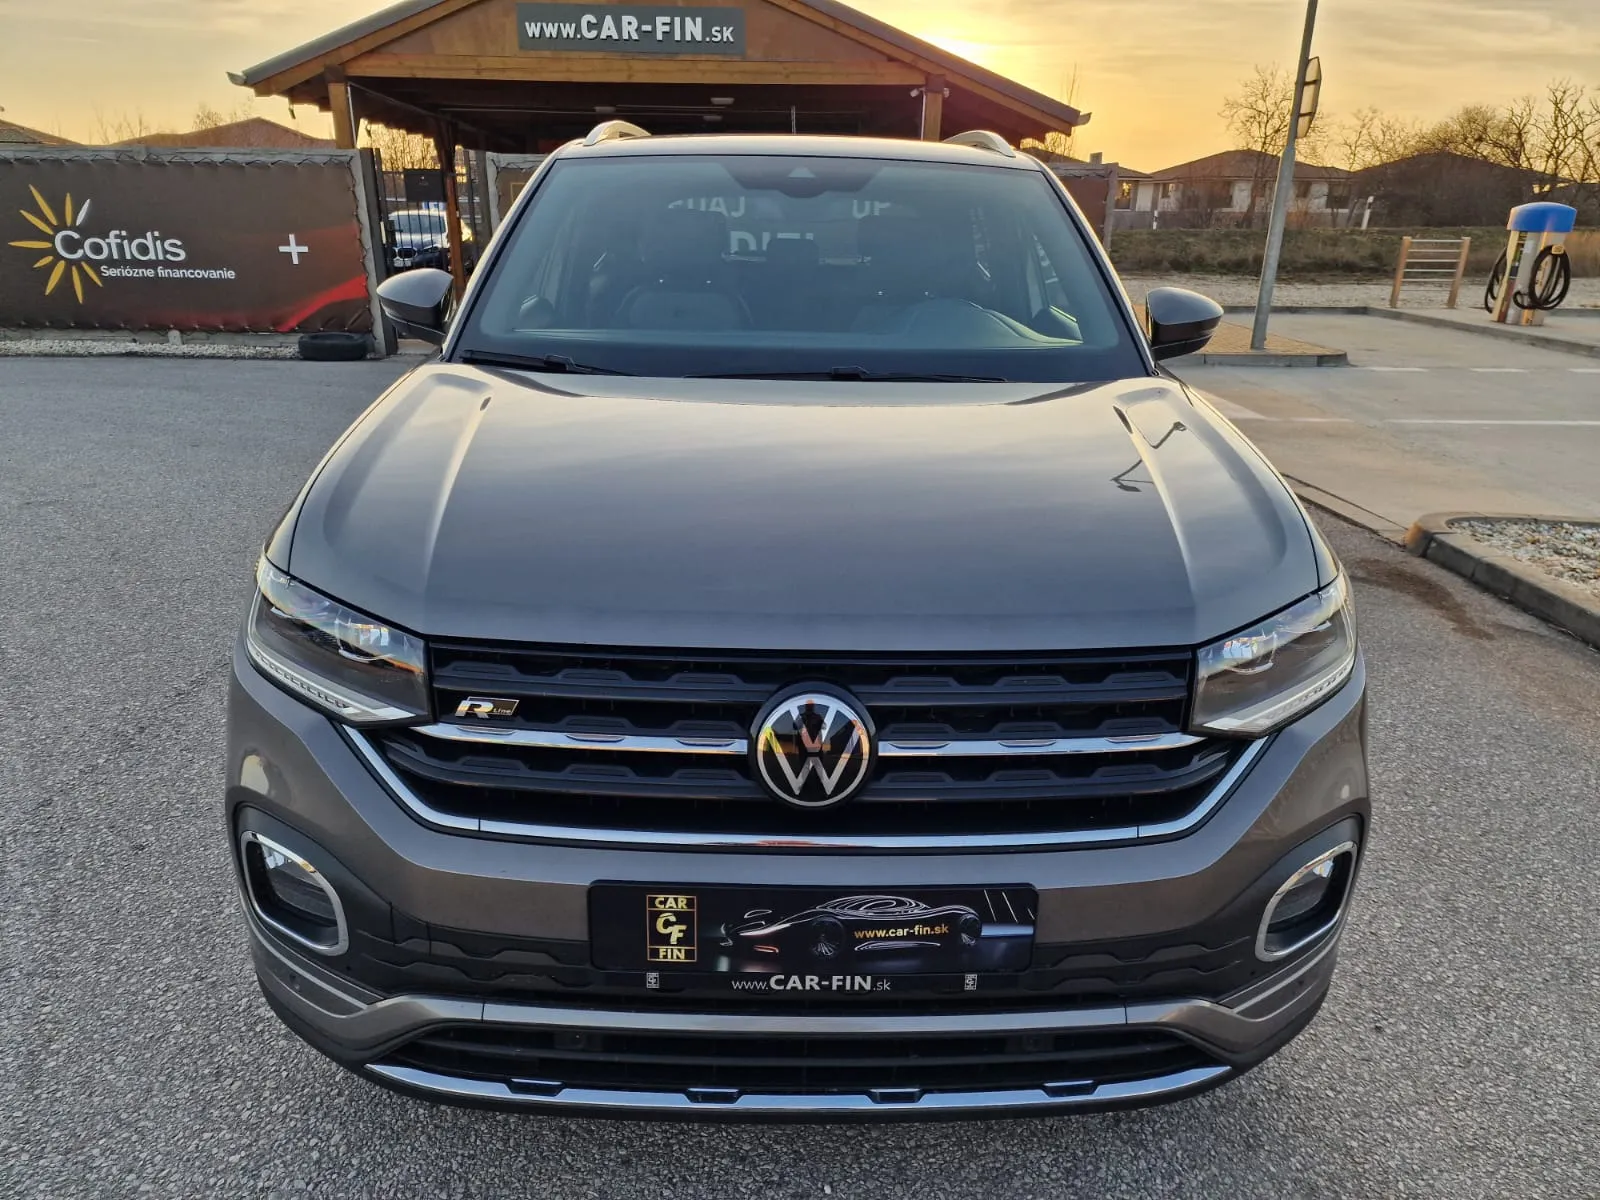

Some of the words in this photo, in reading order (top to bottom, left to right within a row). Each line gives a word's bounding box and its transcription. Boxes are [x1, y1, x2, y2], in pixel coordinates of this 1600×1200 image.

[54, 230, 186, 261] Cofidis
[100, 265, 155, 278] Seriózne
[157, 266, 236, 279] financovanie
[654, 896, 687, 909] CAR
[854, 923, 949, 939] www.car-fin.sk
[659, 948, 686, 960] FIN
[731, 974, 891, 991] www.CAR-FIN.sk
